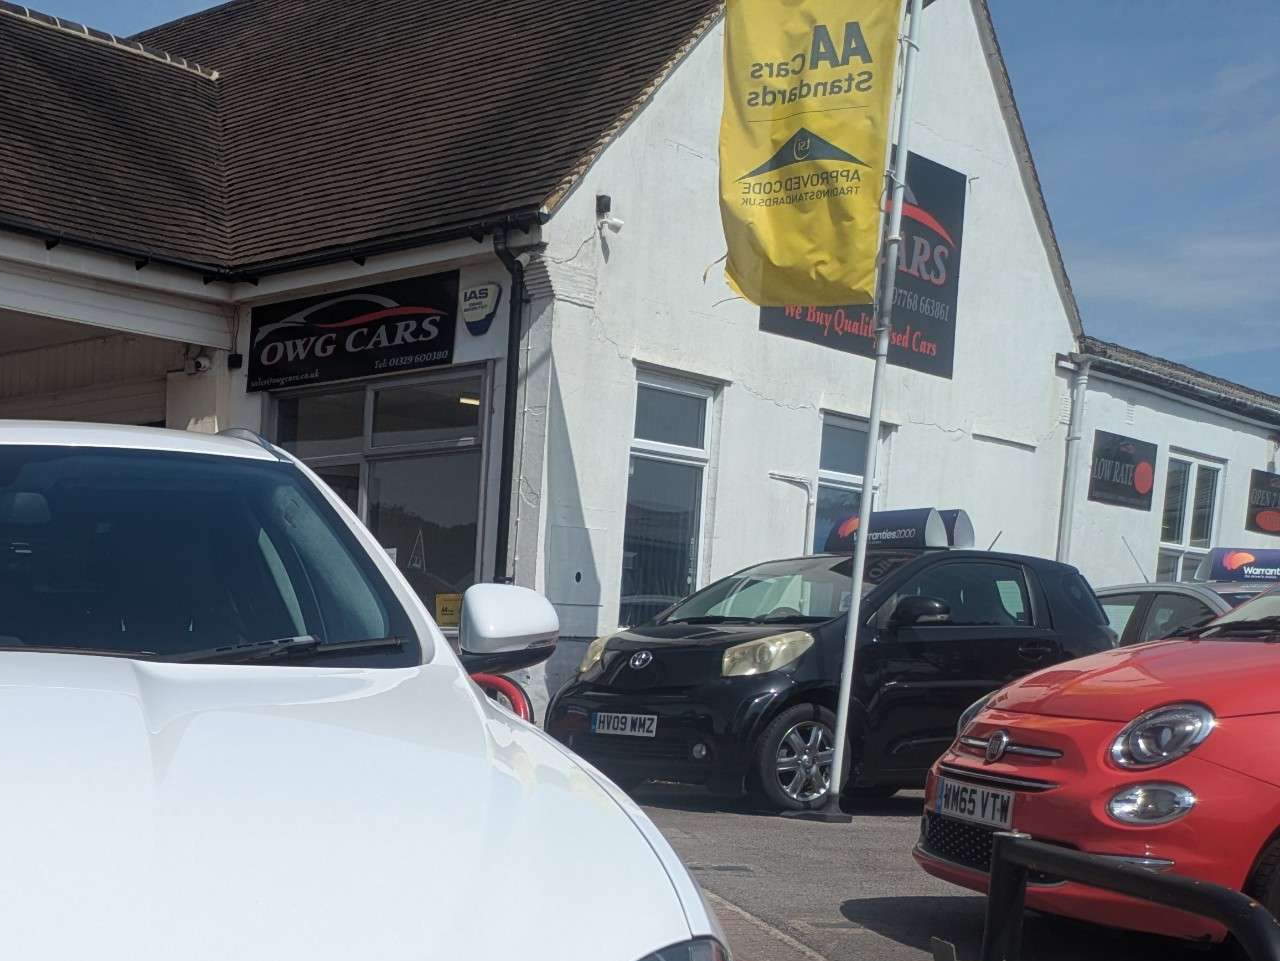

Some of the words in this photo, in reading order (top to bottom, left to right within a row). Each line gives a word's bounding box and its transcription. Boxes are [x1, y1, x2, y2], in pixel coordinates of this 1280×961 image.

[880, 228, 949, 286] ARS
[260, 333, 337, 366] OWG
[345, 316, 441, 352] CARS
[806, 304, 832, 337] Buy
[834, 309, 878, 340] Qualit
[889, 324, 911, 347] sed
[912, 331, 937, 356] Cars
[599, 714, 627, 731] HV09
[630, 716, 655, 733] WMZ
[943, 783, 977, 816] WM65
[981, 790, 1011, 823] VTW
